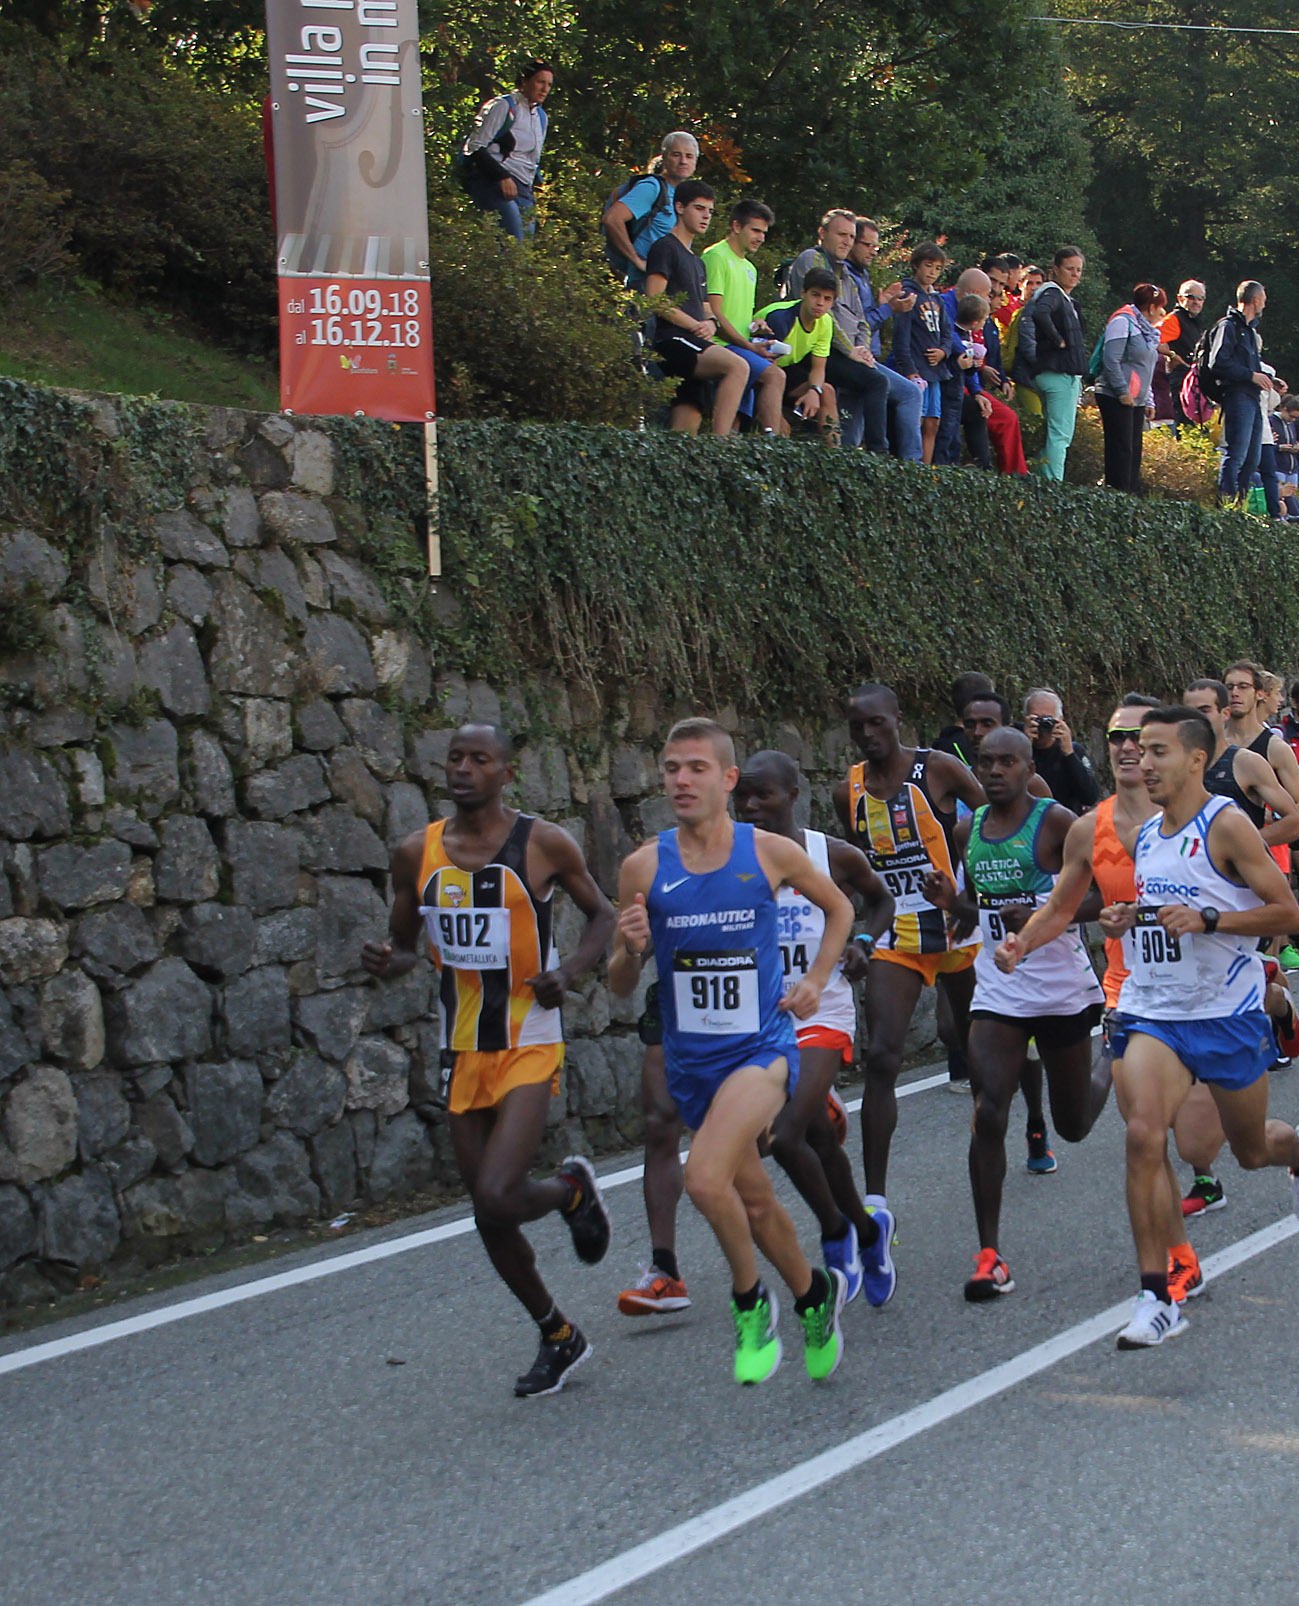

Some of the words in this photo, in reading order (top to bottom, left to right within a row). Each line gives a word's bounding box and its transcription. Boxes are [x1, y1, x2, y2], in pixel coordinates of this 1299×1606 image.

[285, 25, 346, 124] villa
[287, 298, 305, 314] dal
[309, 285, 419, 320] 16.09.18
[295, 329, 307, 345] al
[310, 316, 421, 348] 16.12.18
[885, 853, 928, 868] DIADORA
[974, 857, 1021, 871] ATLETICA
[974, 869, 1024, 883] CASTELLO
[884, 868, 927, 898] 923
[439, 913, 492, 948] 902
[666, 908, 757, 929] AERONAUTICA
[695, 955, 755, 968] DIADORA
[1141, 929, 1182, 964] 909
[691, 975, 741, 1011] 918
